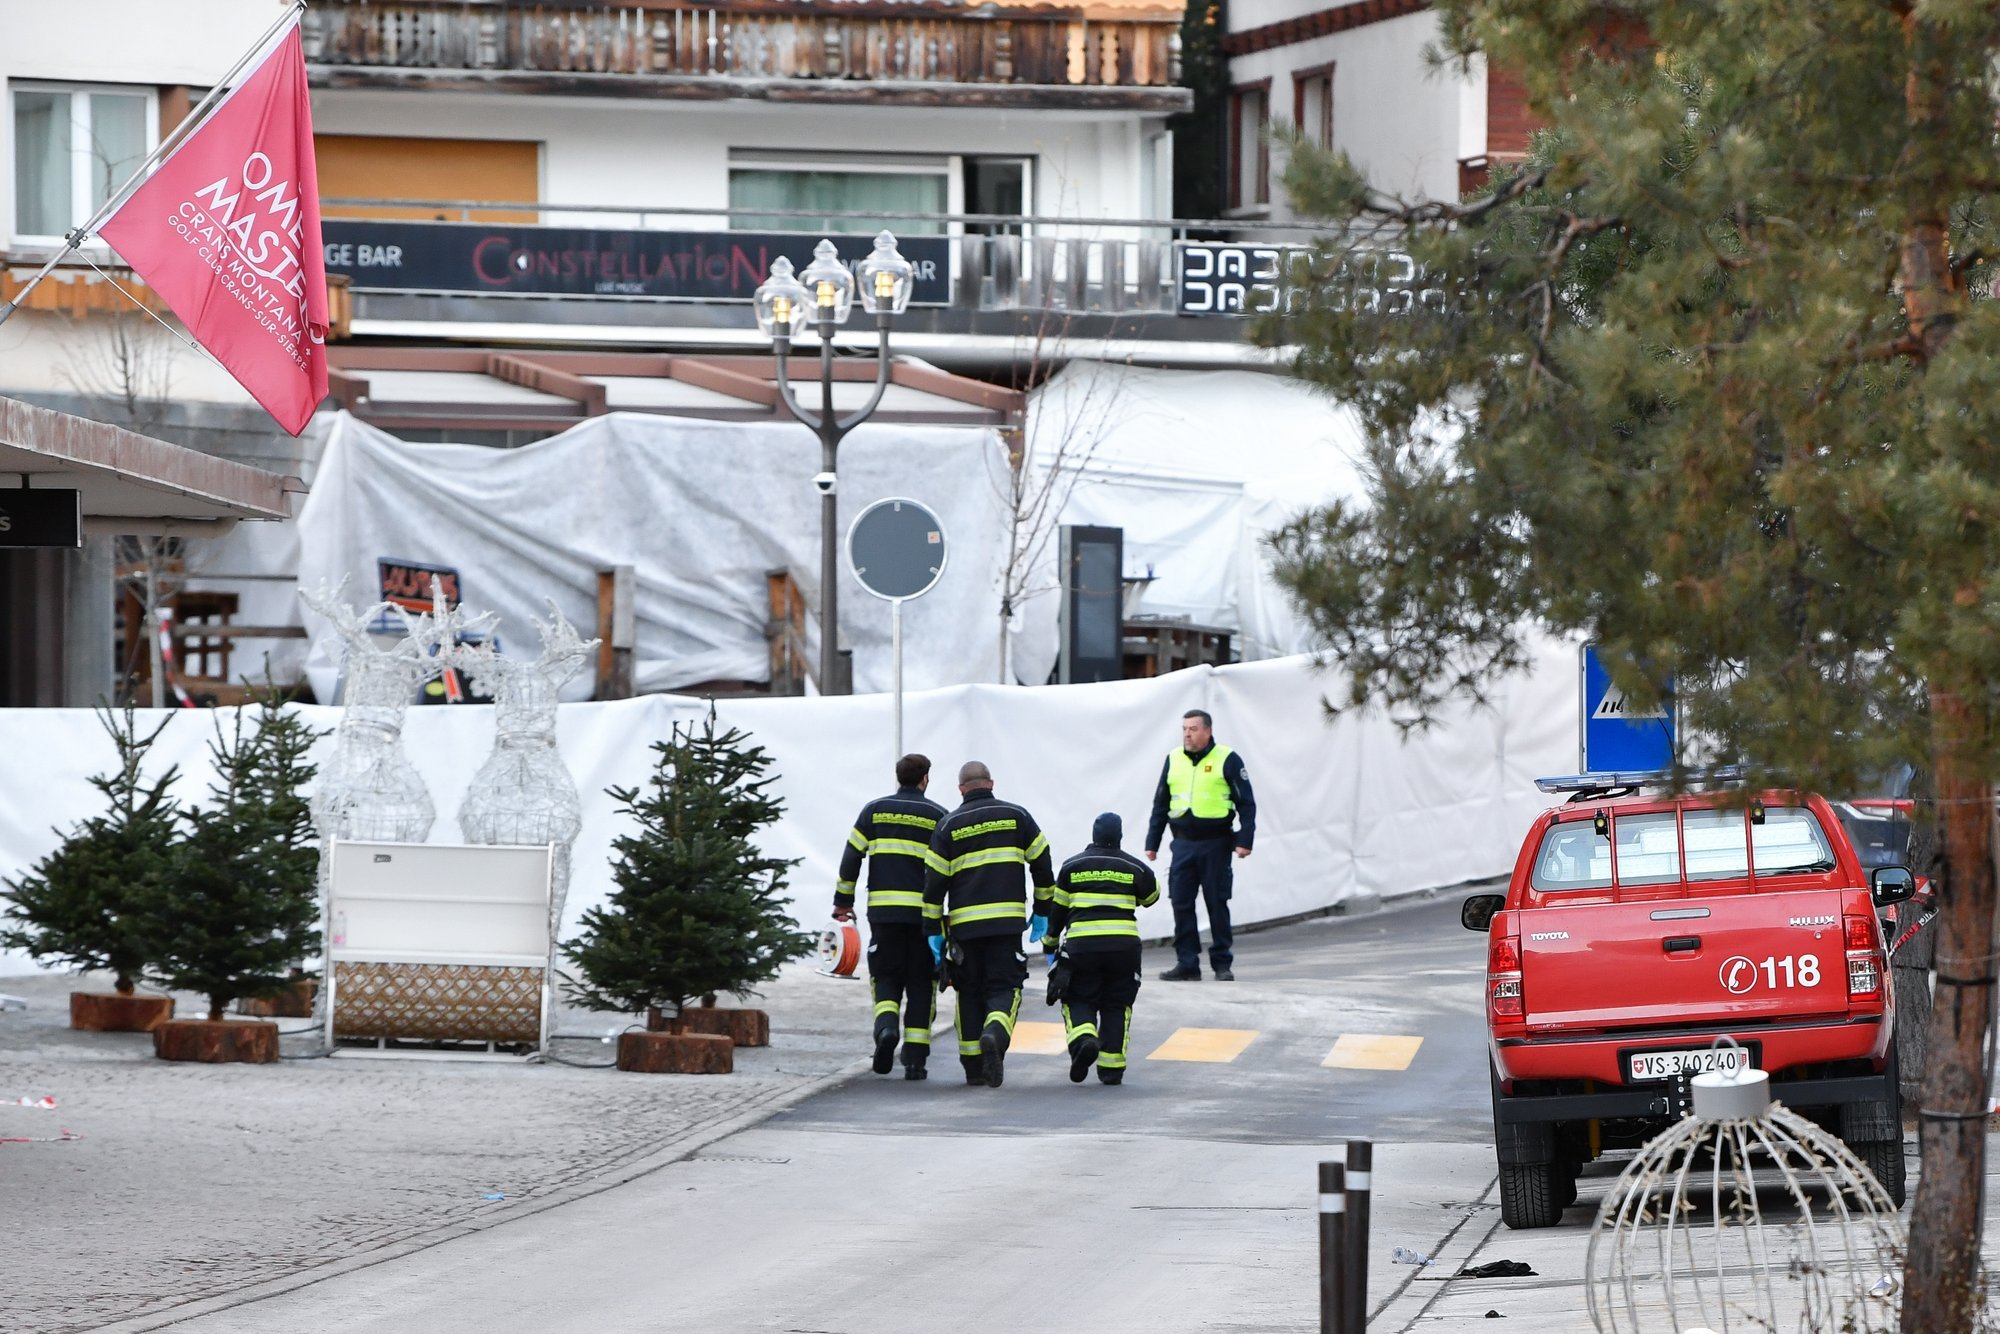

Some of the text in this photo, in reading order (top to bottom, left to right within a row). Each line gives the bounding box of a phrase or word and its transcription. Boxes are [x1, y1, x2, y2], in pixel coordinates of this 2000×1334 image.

[243, 152, 304, 250] OME
[180, 201, 302, 345] CRANS MONTANA
[357, 244, 403, 268] BAR
[168, 215, 308, 372] GOLF CLUB CRANS-SUR-SIERRE
[1530, 931, 1569, 941] TOYOTA
[1789, 915, 1835, 925] HILUX
[1760, 954, 1821, 989] 118
